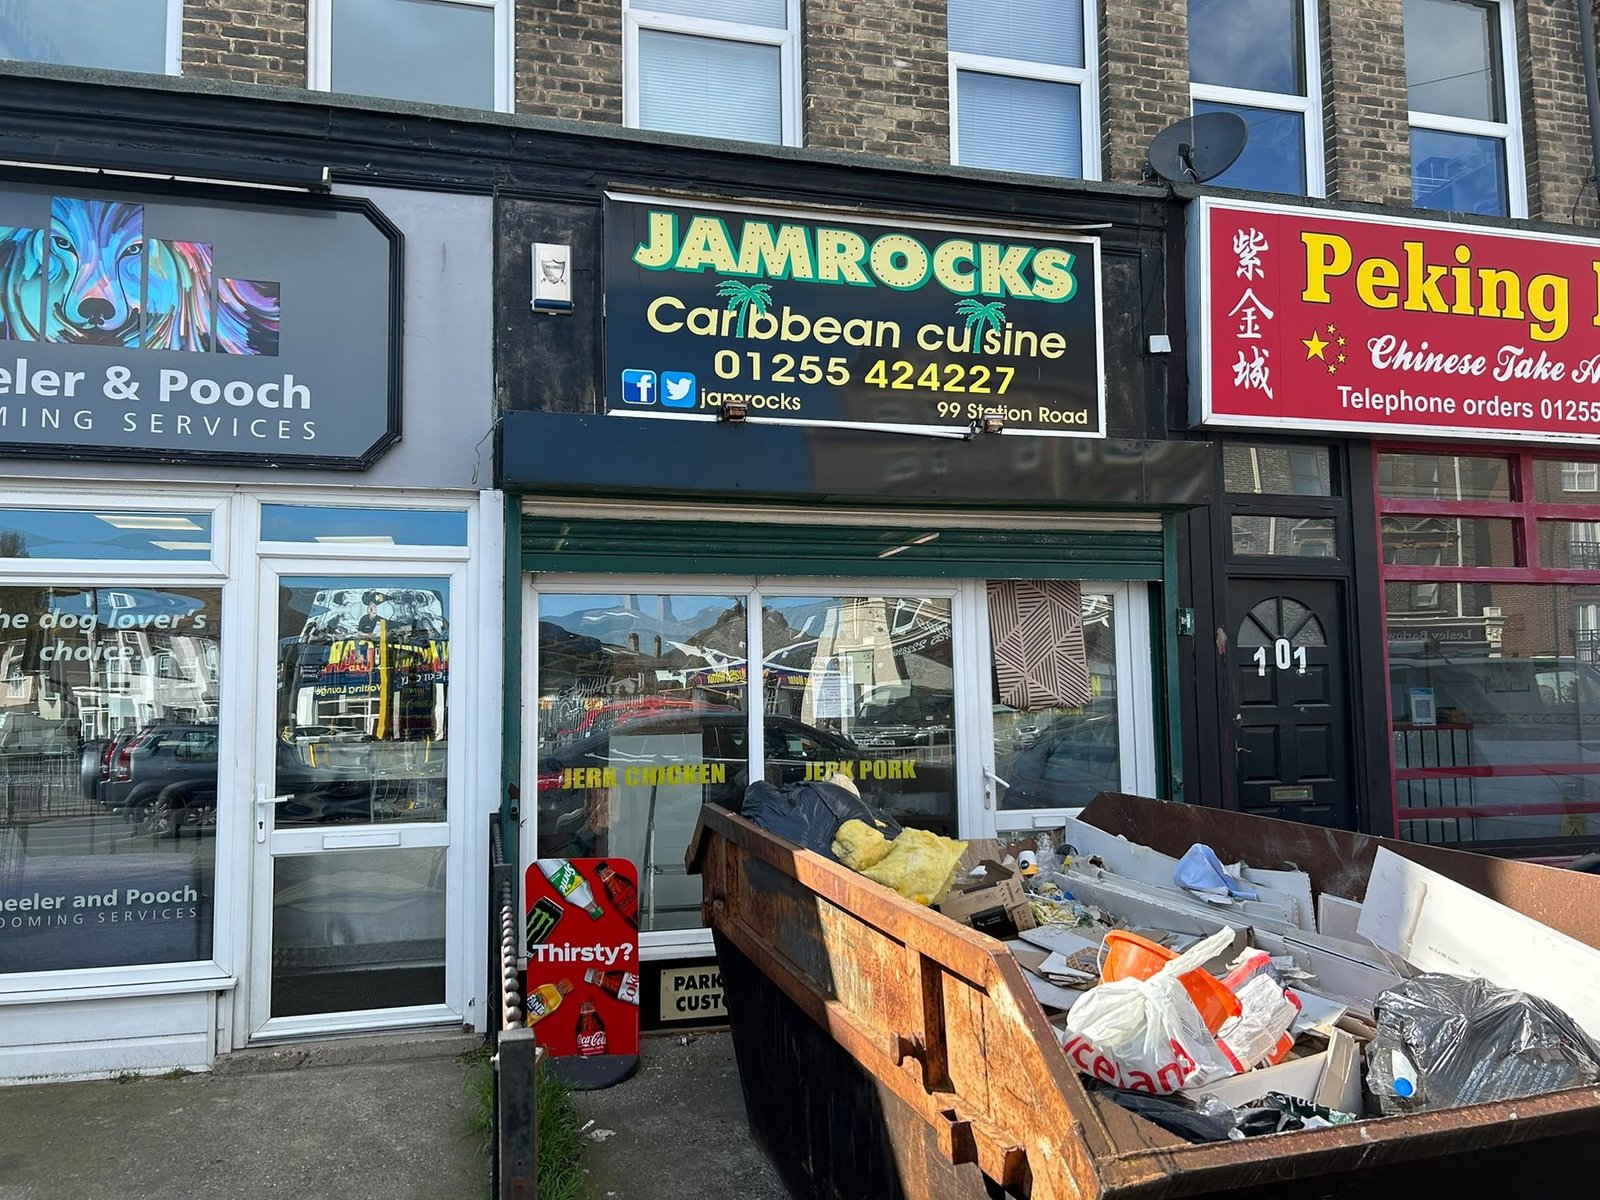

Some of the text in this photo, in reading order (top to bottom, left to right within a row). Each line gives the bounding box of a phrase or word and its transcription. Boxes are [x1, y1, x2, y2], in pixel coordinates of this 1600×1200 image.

[632, 210, 1078, 303] JAMROCKS
[1300, 231, 1570, 342] Peking
[1228, 227, 1274, 400] 紫金城
[1367, 335, 1486, 376] Chinese
[1492, 345, 1565, 382] Take
[714, 349, 1015, 395] 01255 424227
[102, 366, 140, 401] &
[159, 369, 311, 410] Pooch
[700, 388, 801, 411] jamrocks
[937, 401, 961, 418] 99
[1039, 406, 1088, 425] Road
[1337, 385, 1600, 423] Telephone orders 01255
[123, 412, 316, 440] SERVICES
[39, 608, 98, 634] dog
[108, 609, 207, 629] lover's
[40, 639, 142, 661] choice.
[1253, 638, 1307, 676] 101
[562, 763, 726, 789] JERK CHICKEN
[804, 759, 917, 782] JERK PORK
[0, 885, 197, 911] eeler and Pooch
[98, 907, 196, 923] SERVICES
[532, 943, 633, 965] Thirsty?
[673, 973, 723, 991] PARK
